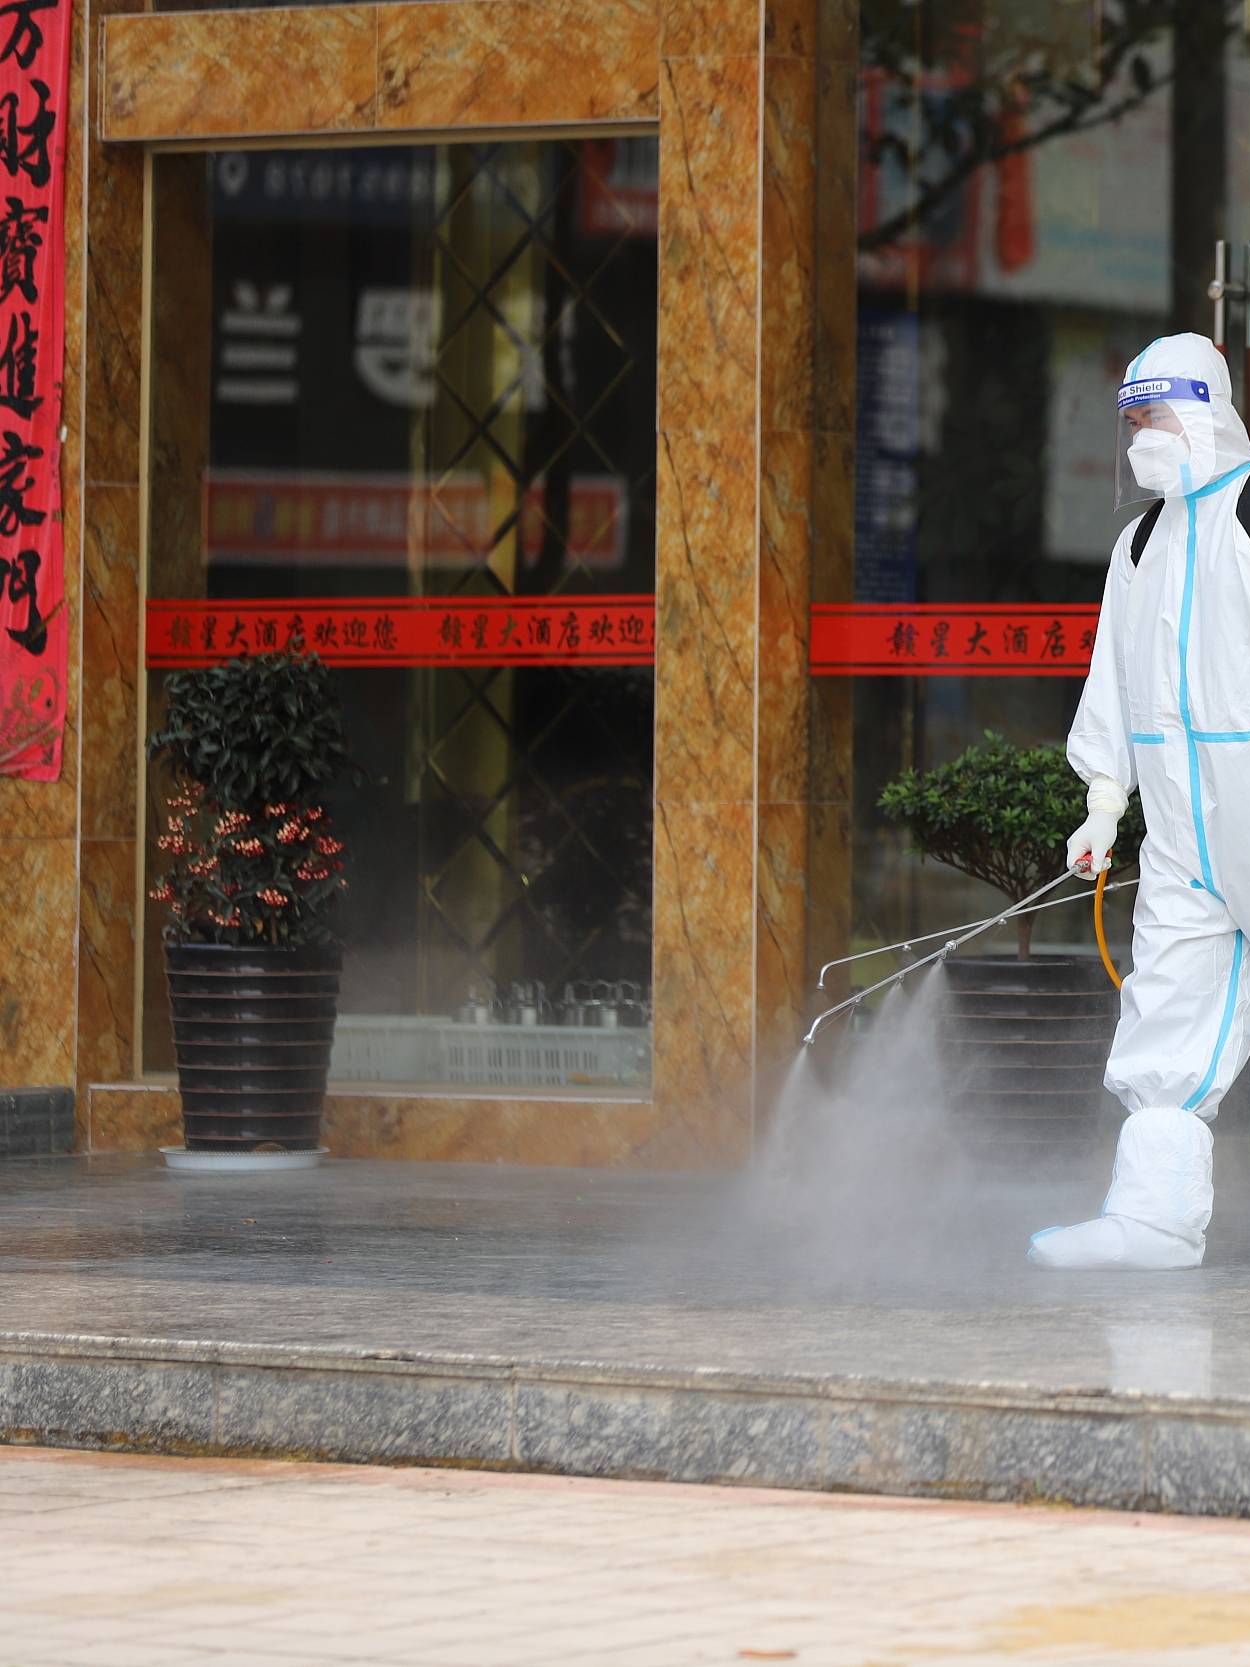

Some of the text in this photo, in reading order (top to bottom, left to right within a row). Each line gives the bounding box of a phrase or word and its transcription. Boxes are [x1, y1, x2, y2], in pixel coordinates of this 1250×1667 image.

[1129, 382, 1163, 395] Shield
[438, 611, 655, 650] 赣星大酒店欢迎
